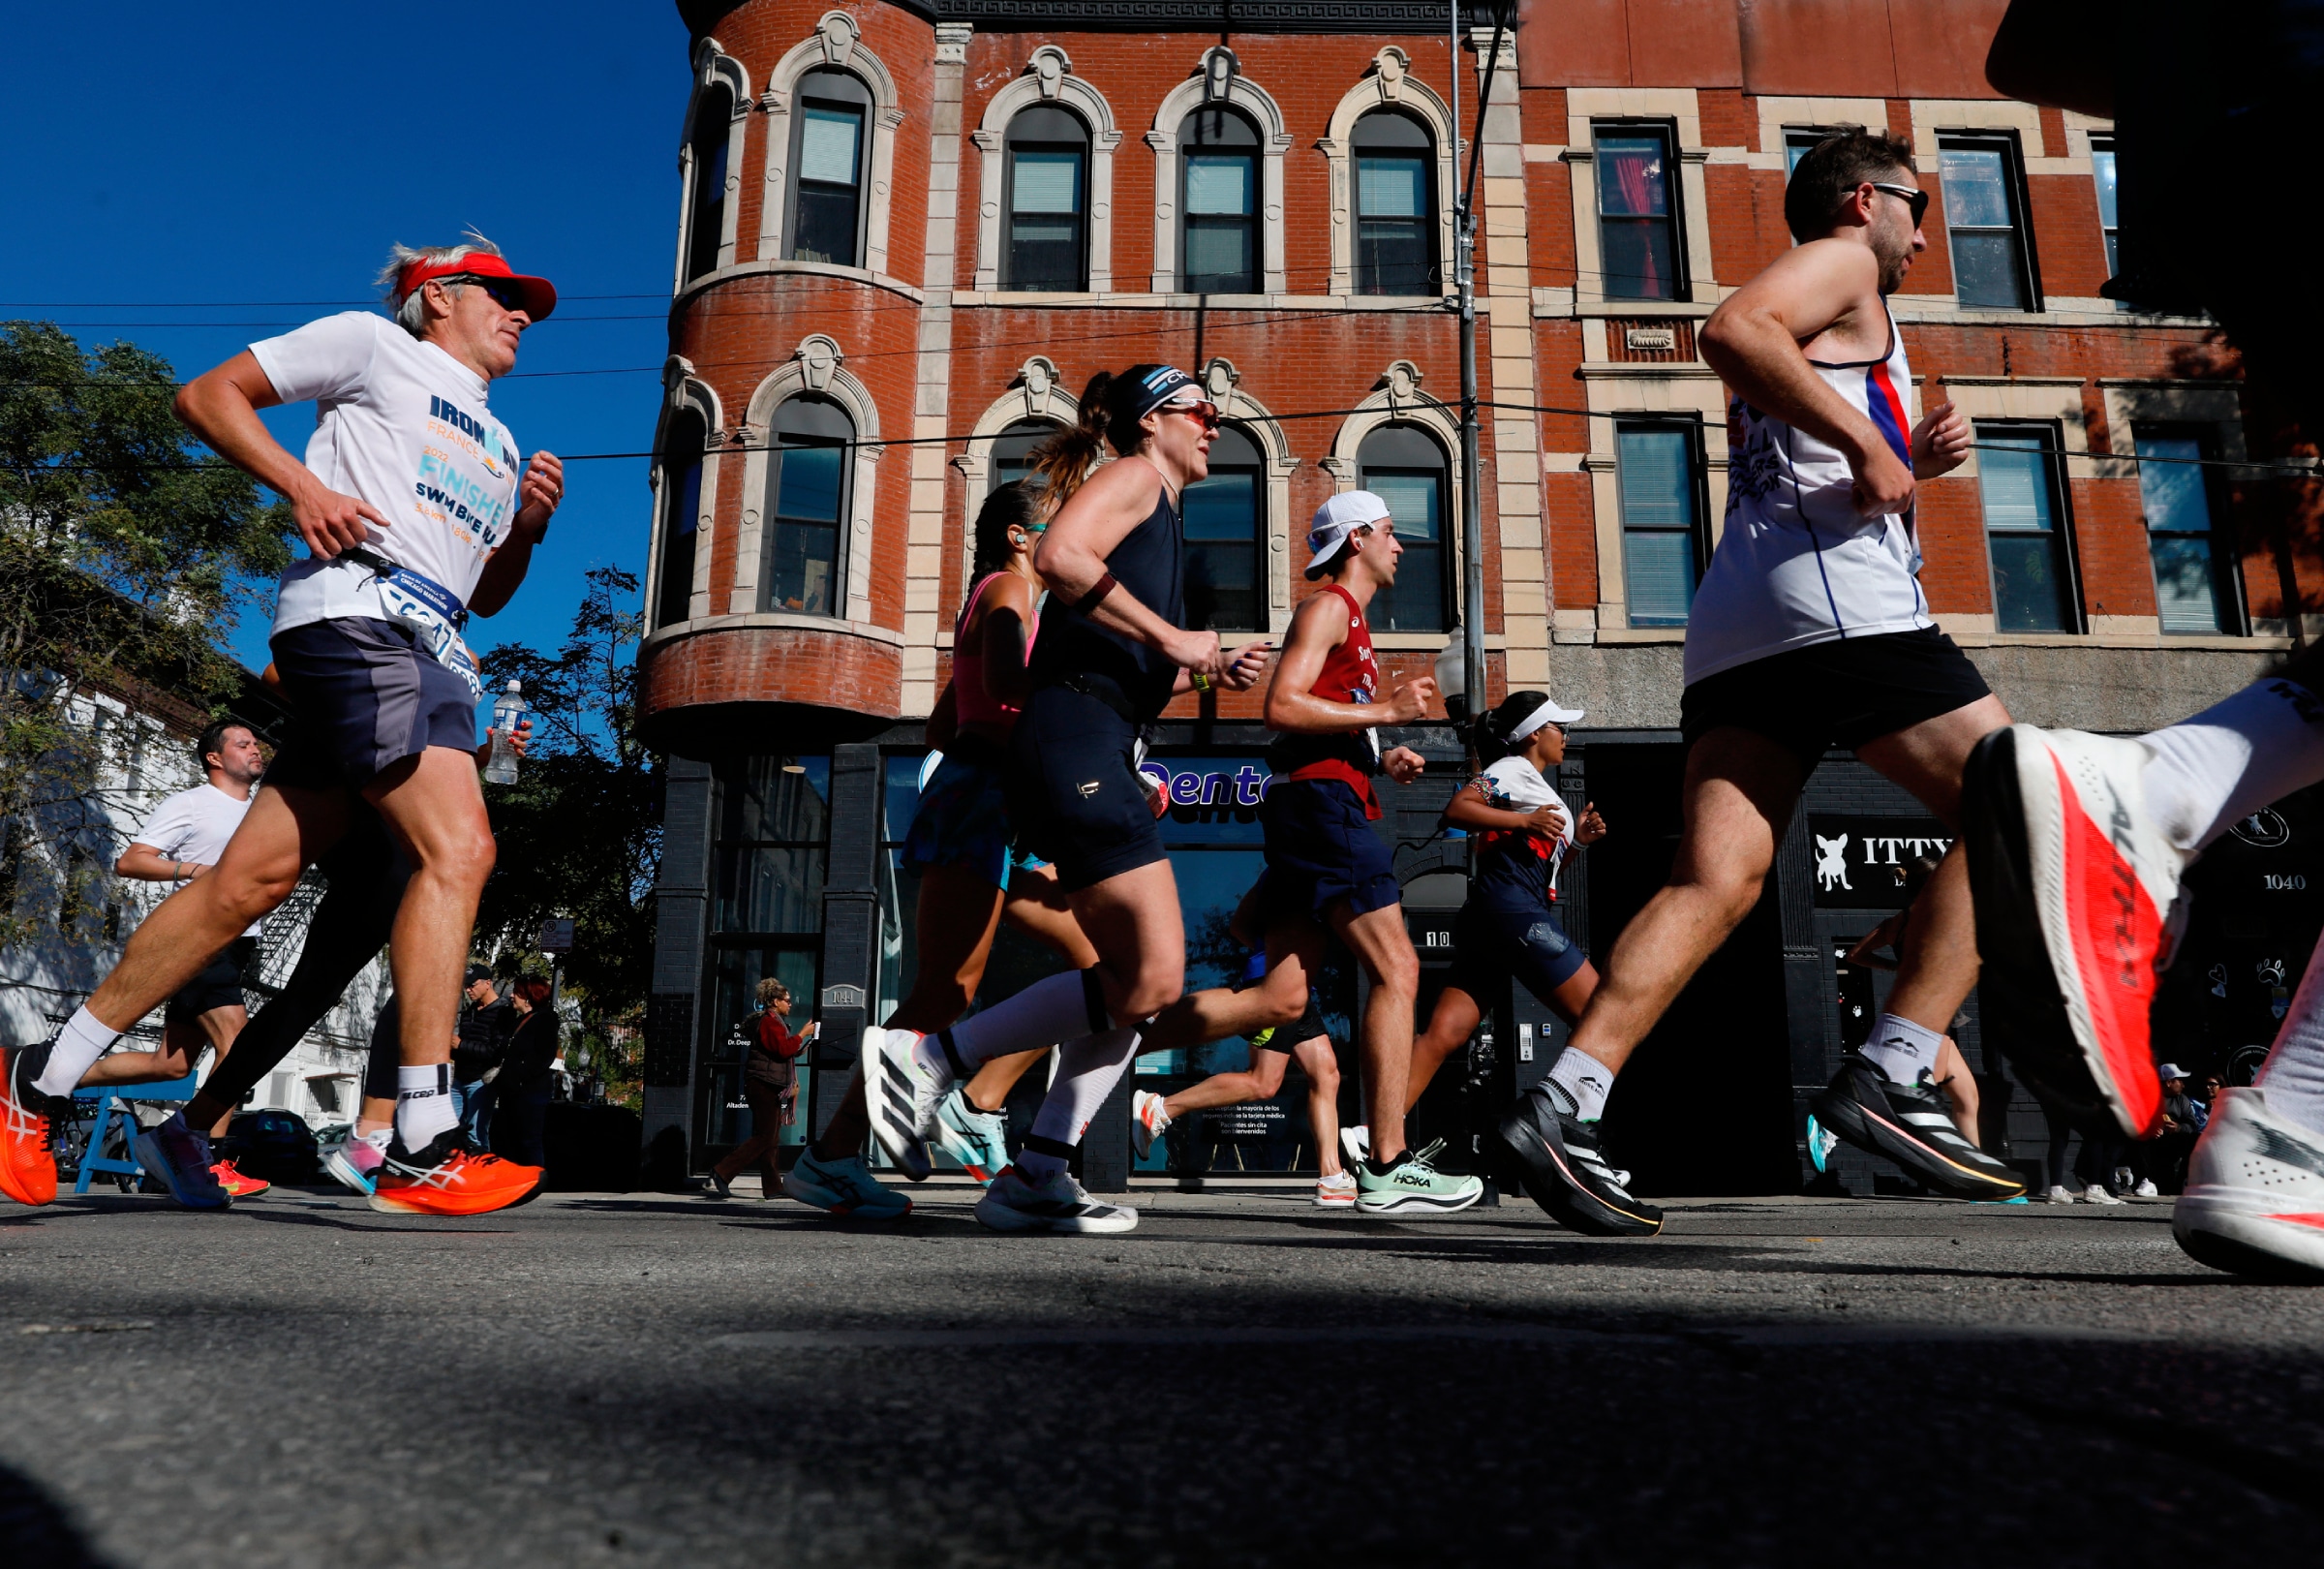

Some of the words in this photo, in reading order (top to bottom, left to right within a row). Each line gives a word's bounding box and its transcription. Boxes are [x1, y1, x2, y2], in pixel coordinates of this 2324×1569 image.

[423, 445, 449, 462] 2022
[427, 419, 479, 460] FRANCE
[415, 481, 456, 512] SWM
[400, 577, 423, 594] CHICAGO
[422, 590, 448, 611] MARATHON
[1140, 761, 1268, 806] Dent
[1862, 837, 1953, 865] ITTY
[2263, 874, 2307, 890] 1040
[833, 990, 853, 1004] 1044
[1392, 1173, 1431, 1188] HOKA
